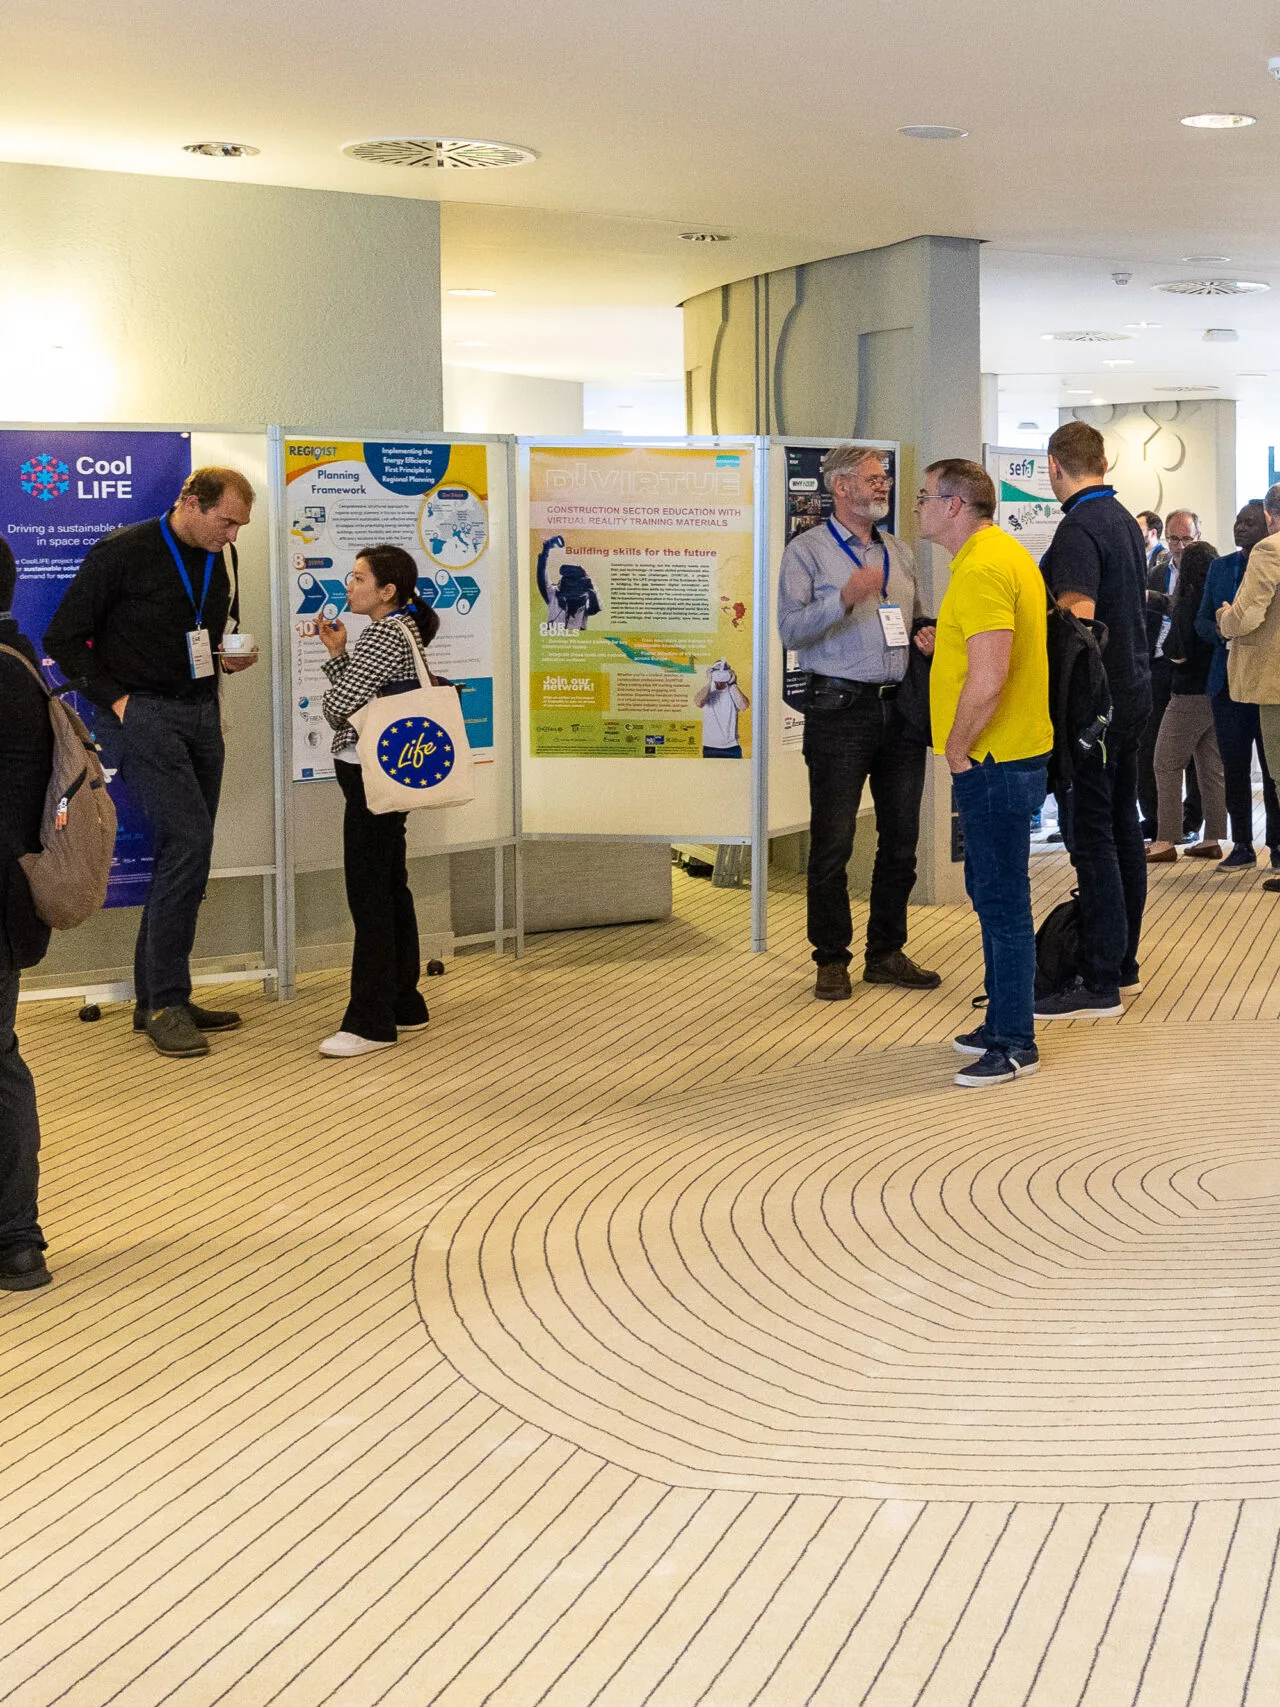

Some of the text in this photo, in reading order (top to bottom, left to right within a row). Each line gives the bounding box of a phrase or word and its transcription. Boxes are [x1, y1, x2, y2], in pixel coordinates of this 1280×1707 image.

[382, 447, 422, 456] Implementing
[76, 455, 132, 475] Cool
[383, 456, 432, 465] Energy Efficiency
[399, 466, 424, 475] Principle
[318, 470, 360, 482] Planning
[382, 475, 435, 484] Regional Planning
[78, 480, 133, 499] LIFE
[312, 485, 367, 495] Framework
[547, 506, 741, 517] CONSTRUCTION SECTOR EDUCATION WITH
[547, 516, 728, 527] VIRTUAL REALITY TRAINING MATERIALS
[8, 524, 46, 535] Driving
[48, 525, 54, 533] a
[57, 523, 115, 533] sustainable
[36, 536, 46, 546] in
[49, 537, 80, 548] space
[565, 546, 718, 557] Building skills for the future
[51, 558, 73, 566] project
[293, 553, 306, 570] 8
[19, 573, 45, 581] demand
[539, 622, 566, 630] OUR
[539, 629, 580, 637] GOALS
[543, 675, 568, 685] Join
[543, 683, 595, 691] network!
[397, 732, 437, 769] Life
